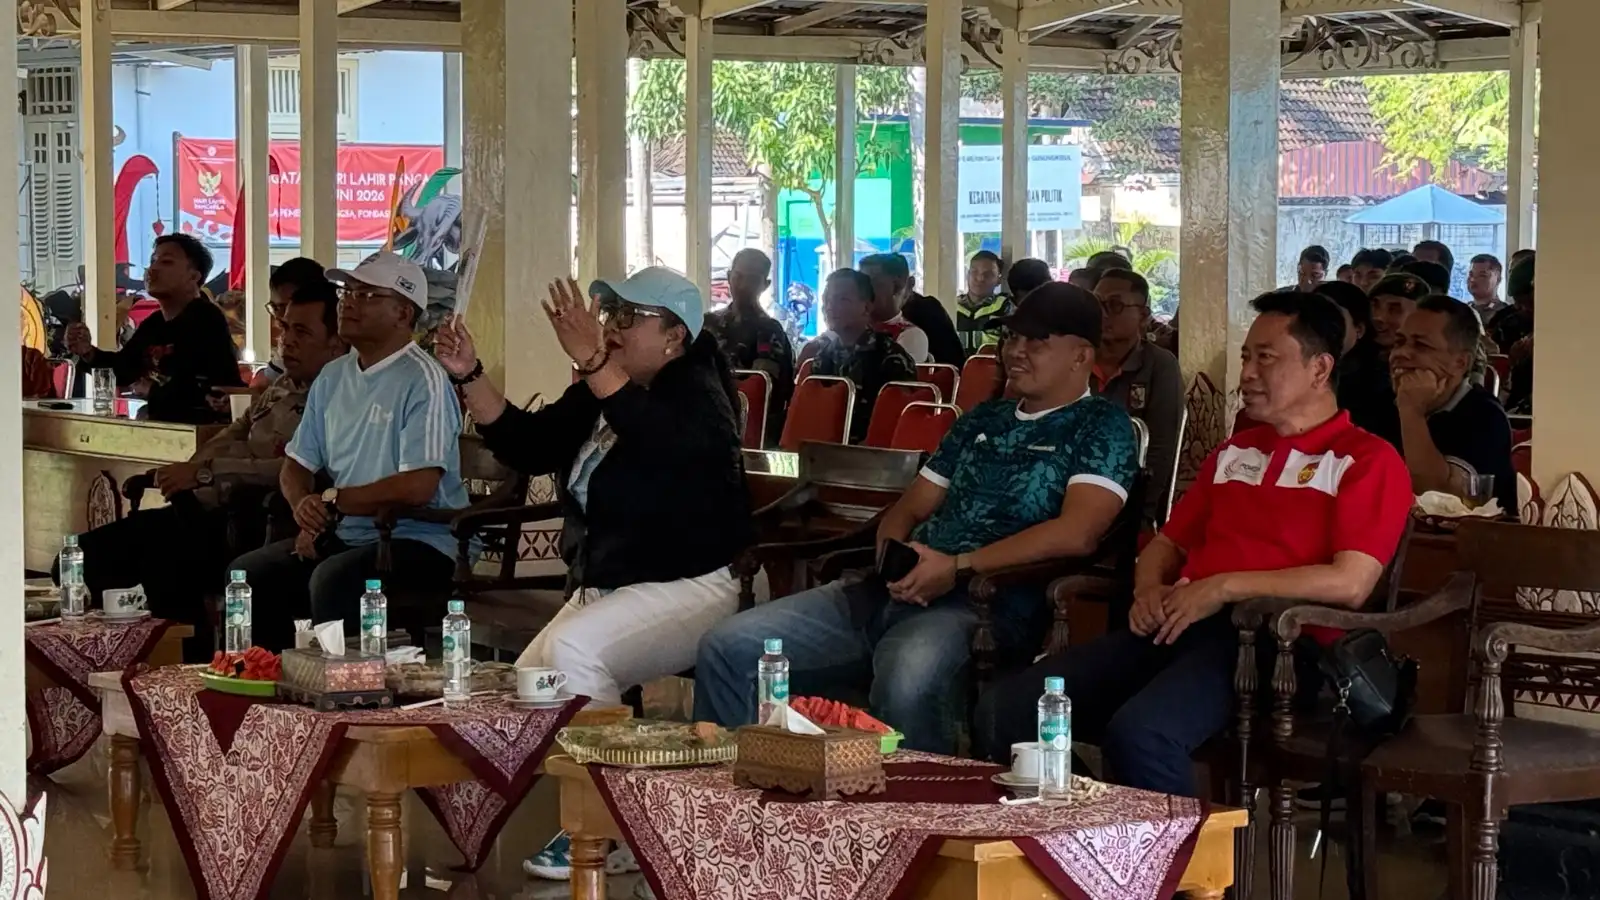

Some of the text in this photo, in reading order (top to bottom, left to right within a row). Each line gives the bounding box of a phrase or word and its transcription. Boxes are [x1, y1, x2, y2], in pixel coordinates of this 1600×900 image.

[349, 172, 386, 186] LAHIR
[356, 190, 385, 202] 2026
[1041, 188, 1063, 203] POLITIK
